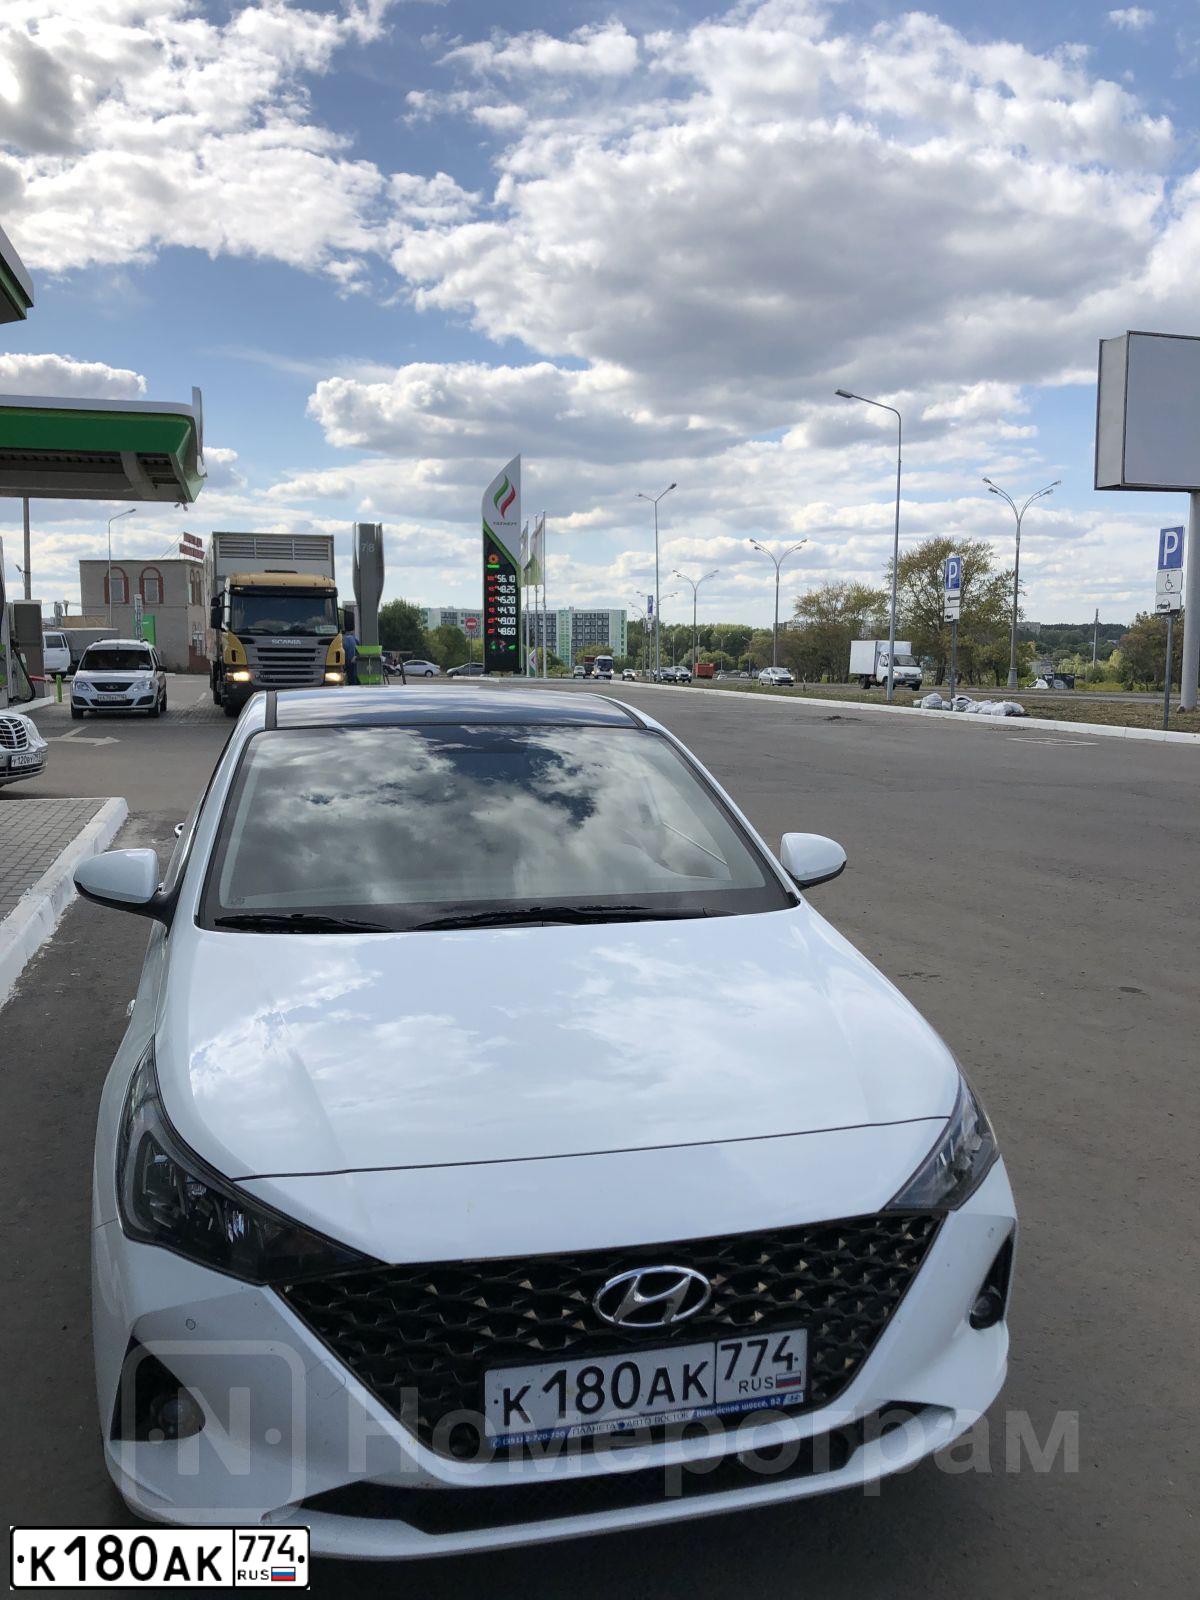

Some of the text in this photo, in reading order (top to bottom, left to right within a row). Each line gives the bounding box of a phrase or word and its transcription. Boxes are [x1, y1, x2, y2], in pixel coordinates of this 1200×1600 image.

[1163, 531, 1178, 565] P
[948, 561, 958, 587] P
[502, 1335, 795, 1427] К180АК 774
[738, 1376, 774, 1394] RUS
